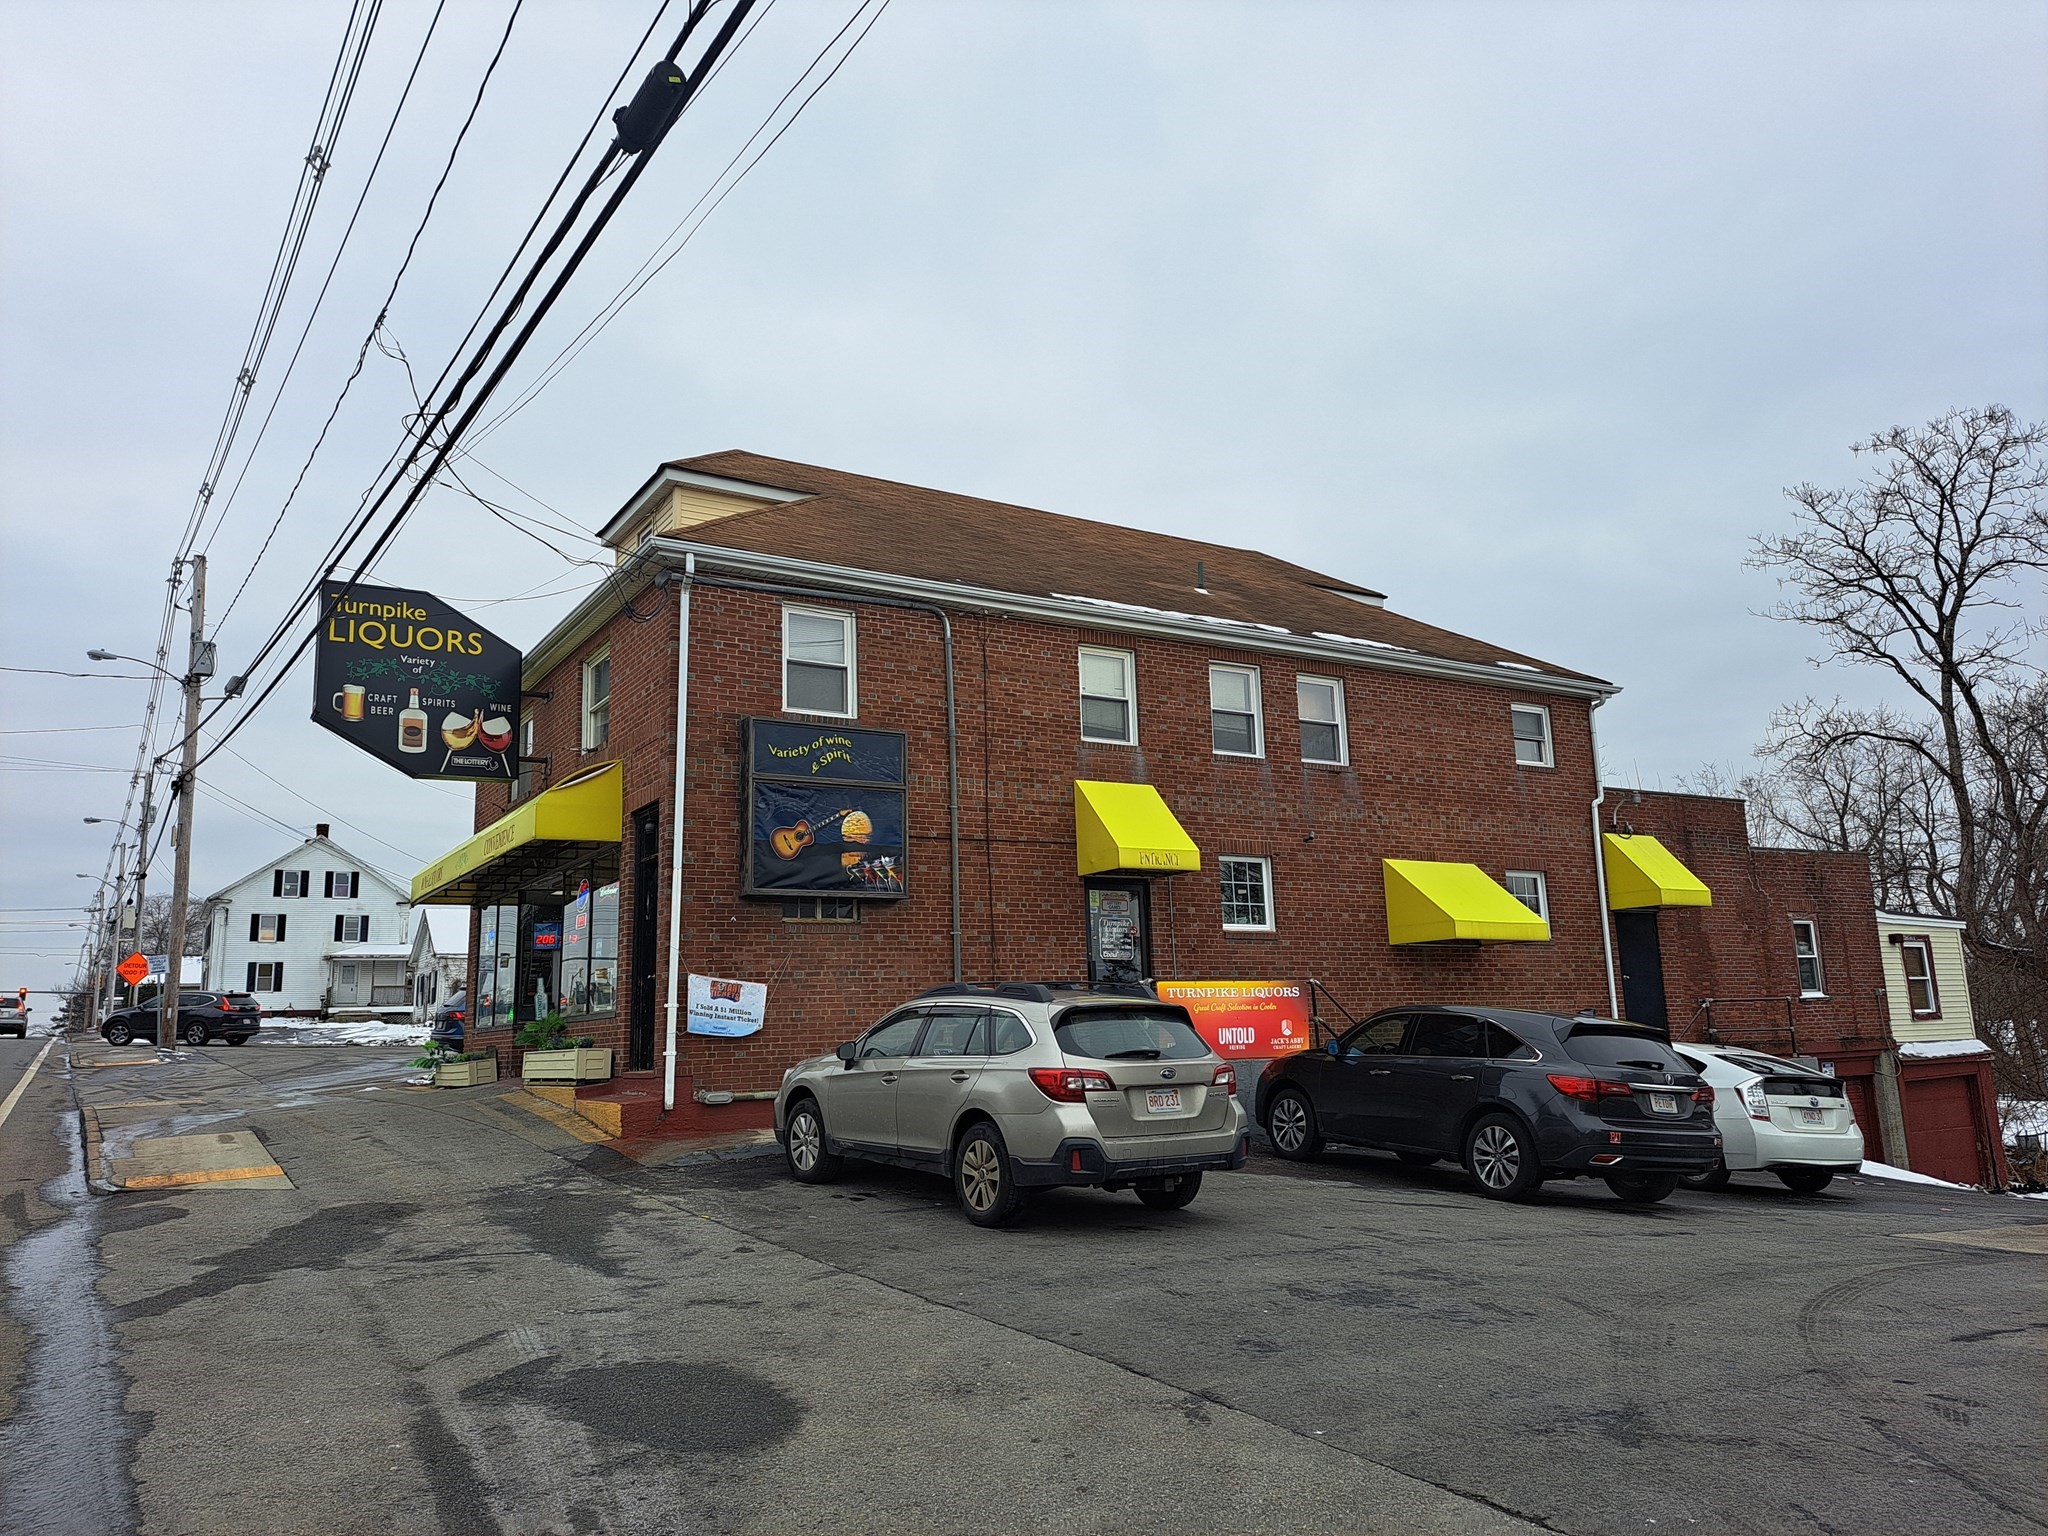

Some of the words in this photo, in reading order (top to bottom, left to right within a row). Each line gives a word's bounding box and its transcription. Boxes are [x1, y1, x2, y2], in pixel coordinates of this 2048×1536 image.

[330, 593, 427, 621] Turnpike
[328, 618, 483, 655] LIQUORS
[400, 655, 435, 667] Variety
[412, 666, 423, 674] of
[368, 693, 398, 704] CRAFT
[422, 697, 456, 708] SPIRITS
[370, 706, 394, 716] BEER
[490, 702, 512, 713] WINE
[768, 743, 809, 758] Variety
[812, 736, 825, 749] of
[825, 734, 852, 748] wine
[811, 762, 820, 774] &
[820, 748, 852, 767] Spirit
[536, 934, 555, 944] 206
[1166, 986, 1240, 999] TURNPIKE
[1242, 986, 1300, 999] LIQUORS
[1193, 1002, 1209, 1014] Great
[1210, 1002, 1226, 1013] Craft
[1227, 1002, 1252, 1012] Selection
[1260, 1002, 1277, 1011] Cooler
[689, 1010, 713, 1019] Winning
[1218, 1027, 1255, 1045] UNTOLD
[1149, 1094, 1164, 1107] 8RD
[1165, 1094, 1180, 1107] 231
